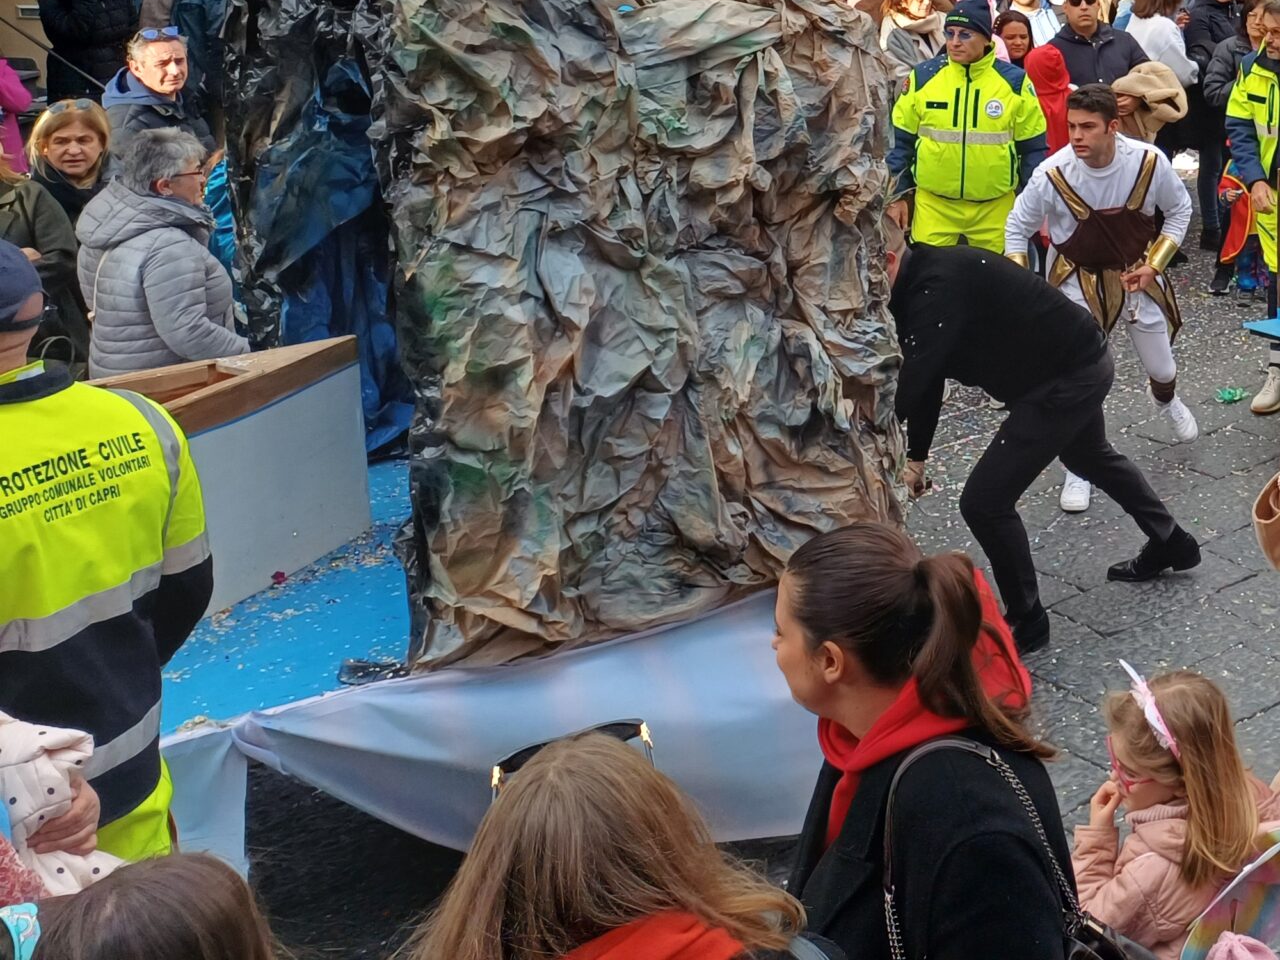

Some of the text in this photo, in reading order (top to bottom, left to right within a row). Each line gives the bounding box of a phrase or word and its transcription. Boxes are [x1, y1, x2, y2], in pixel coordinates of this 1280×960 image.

[0, 432, 146, 497] ROTEZIONE CIVILE
[0, 454, 151, 519] GRUPPO COMUNALE VOLONTARI
[75, 495, 87, 511] DI
[89, 484, 121, 505] CAPRI
